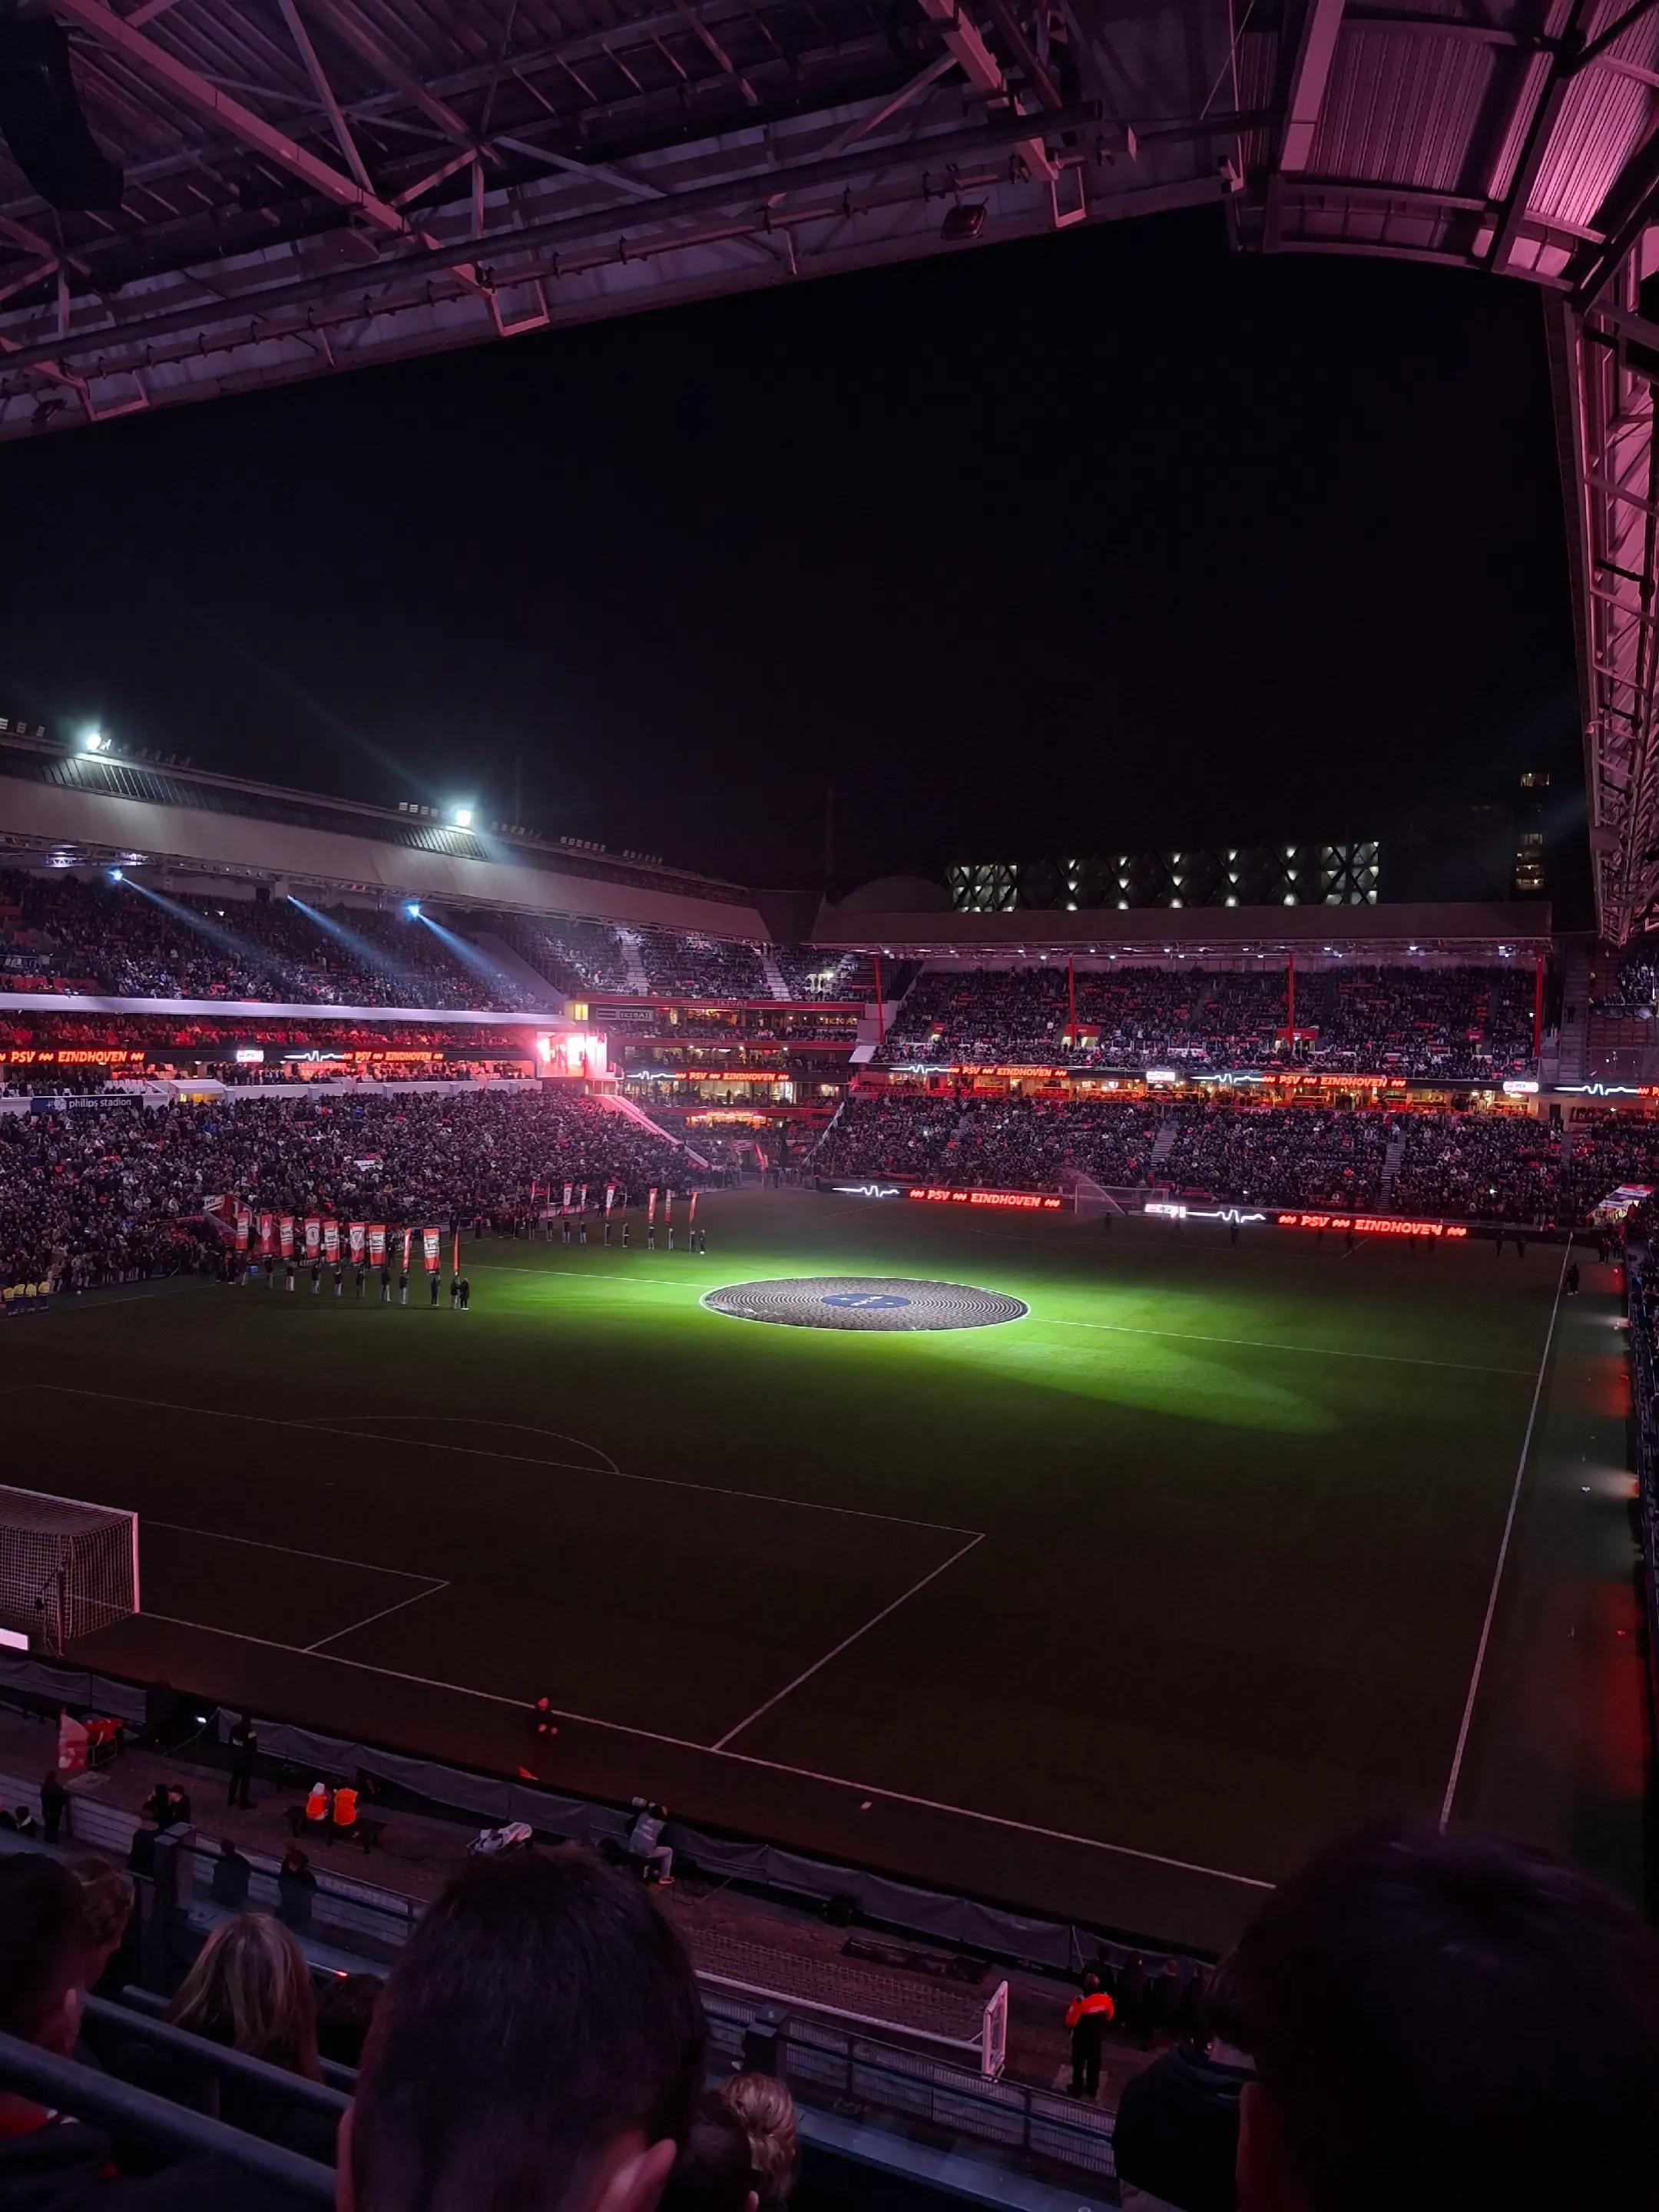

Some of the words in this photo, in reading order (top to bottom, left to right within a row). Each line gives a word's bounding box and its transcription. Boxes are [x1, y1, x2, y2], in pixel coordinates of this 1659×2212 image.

[620, 1012, 649, 1020] IKIGAI
[11, 1051, 35, 1062] PSV
[58, 1051, 127, 1062] EINDHOVEN
[356, 1052, 372, 1061] PSV
[386, 1052, 432, 1061] EINDHOVEN
[962, 1067, 980, 1075] PSV
[996, 1068, 1052, 1077] EINDHOVEN
[1279, 1075, 1300, 1084] PSV
[1320, 1077, 1388, 1088] EINDHOVEN
[69, 1099, 98, 1109] philips
[100, 1098, 131, 1107] stadion
[927, 1190, 950, 1200] PSV
[971, 1194, 1041, 1207] EINDHOVEN
[1301, 1216, 1330, 1227] PSV
[1355, 1220, 1442, 1235] EINDHOVEN
